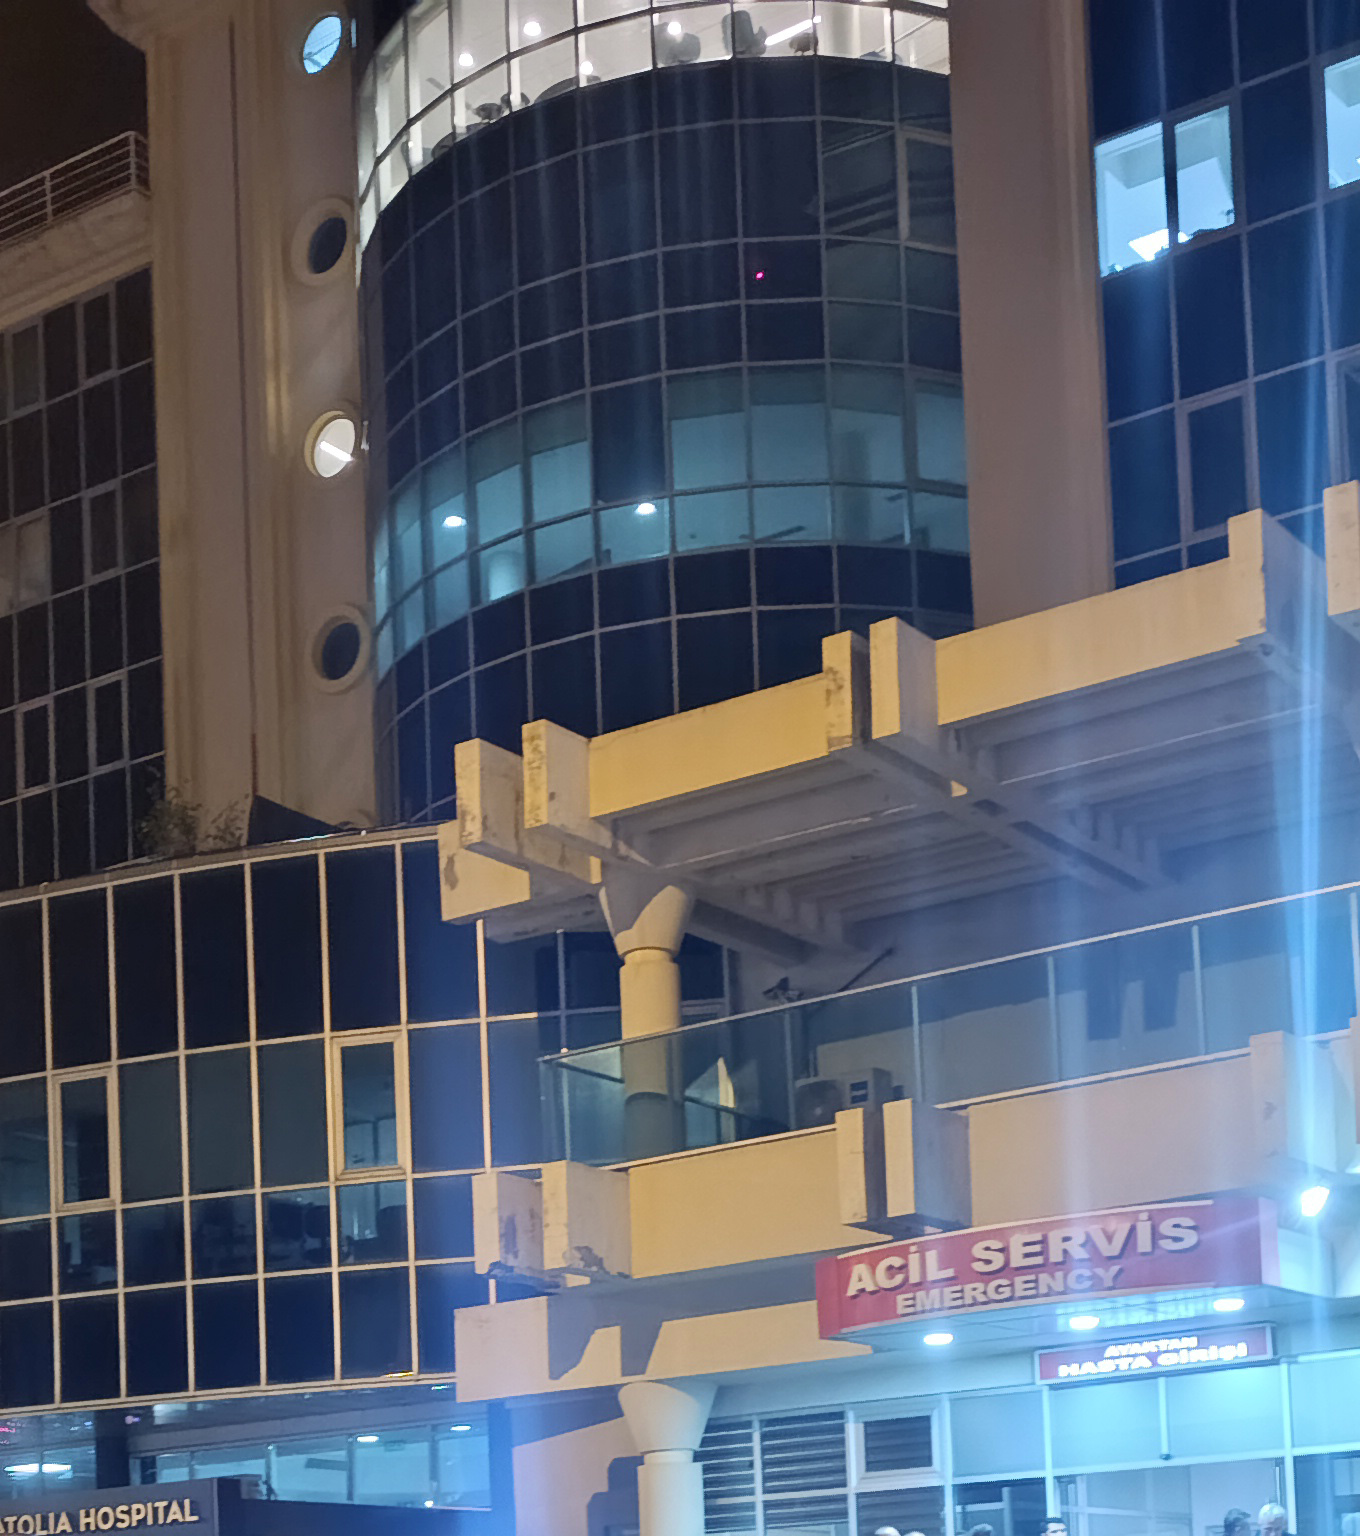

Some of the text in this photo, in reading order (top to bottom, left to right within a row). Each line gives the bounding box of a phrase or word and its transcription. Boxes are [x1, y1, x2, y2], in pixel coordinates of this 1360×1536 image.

[845, 1212, 1200, 1298] ACİL SERVİS
[895, 1264, 1122, 1316] EMERGENCY
[1058, 1355, 1152, 1377] HASTA
[79, 1498, 199, 1532] HOSPITAL
